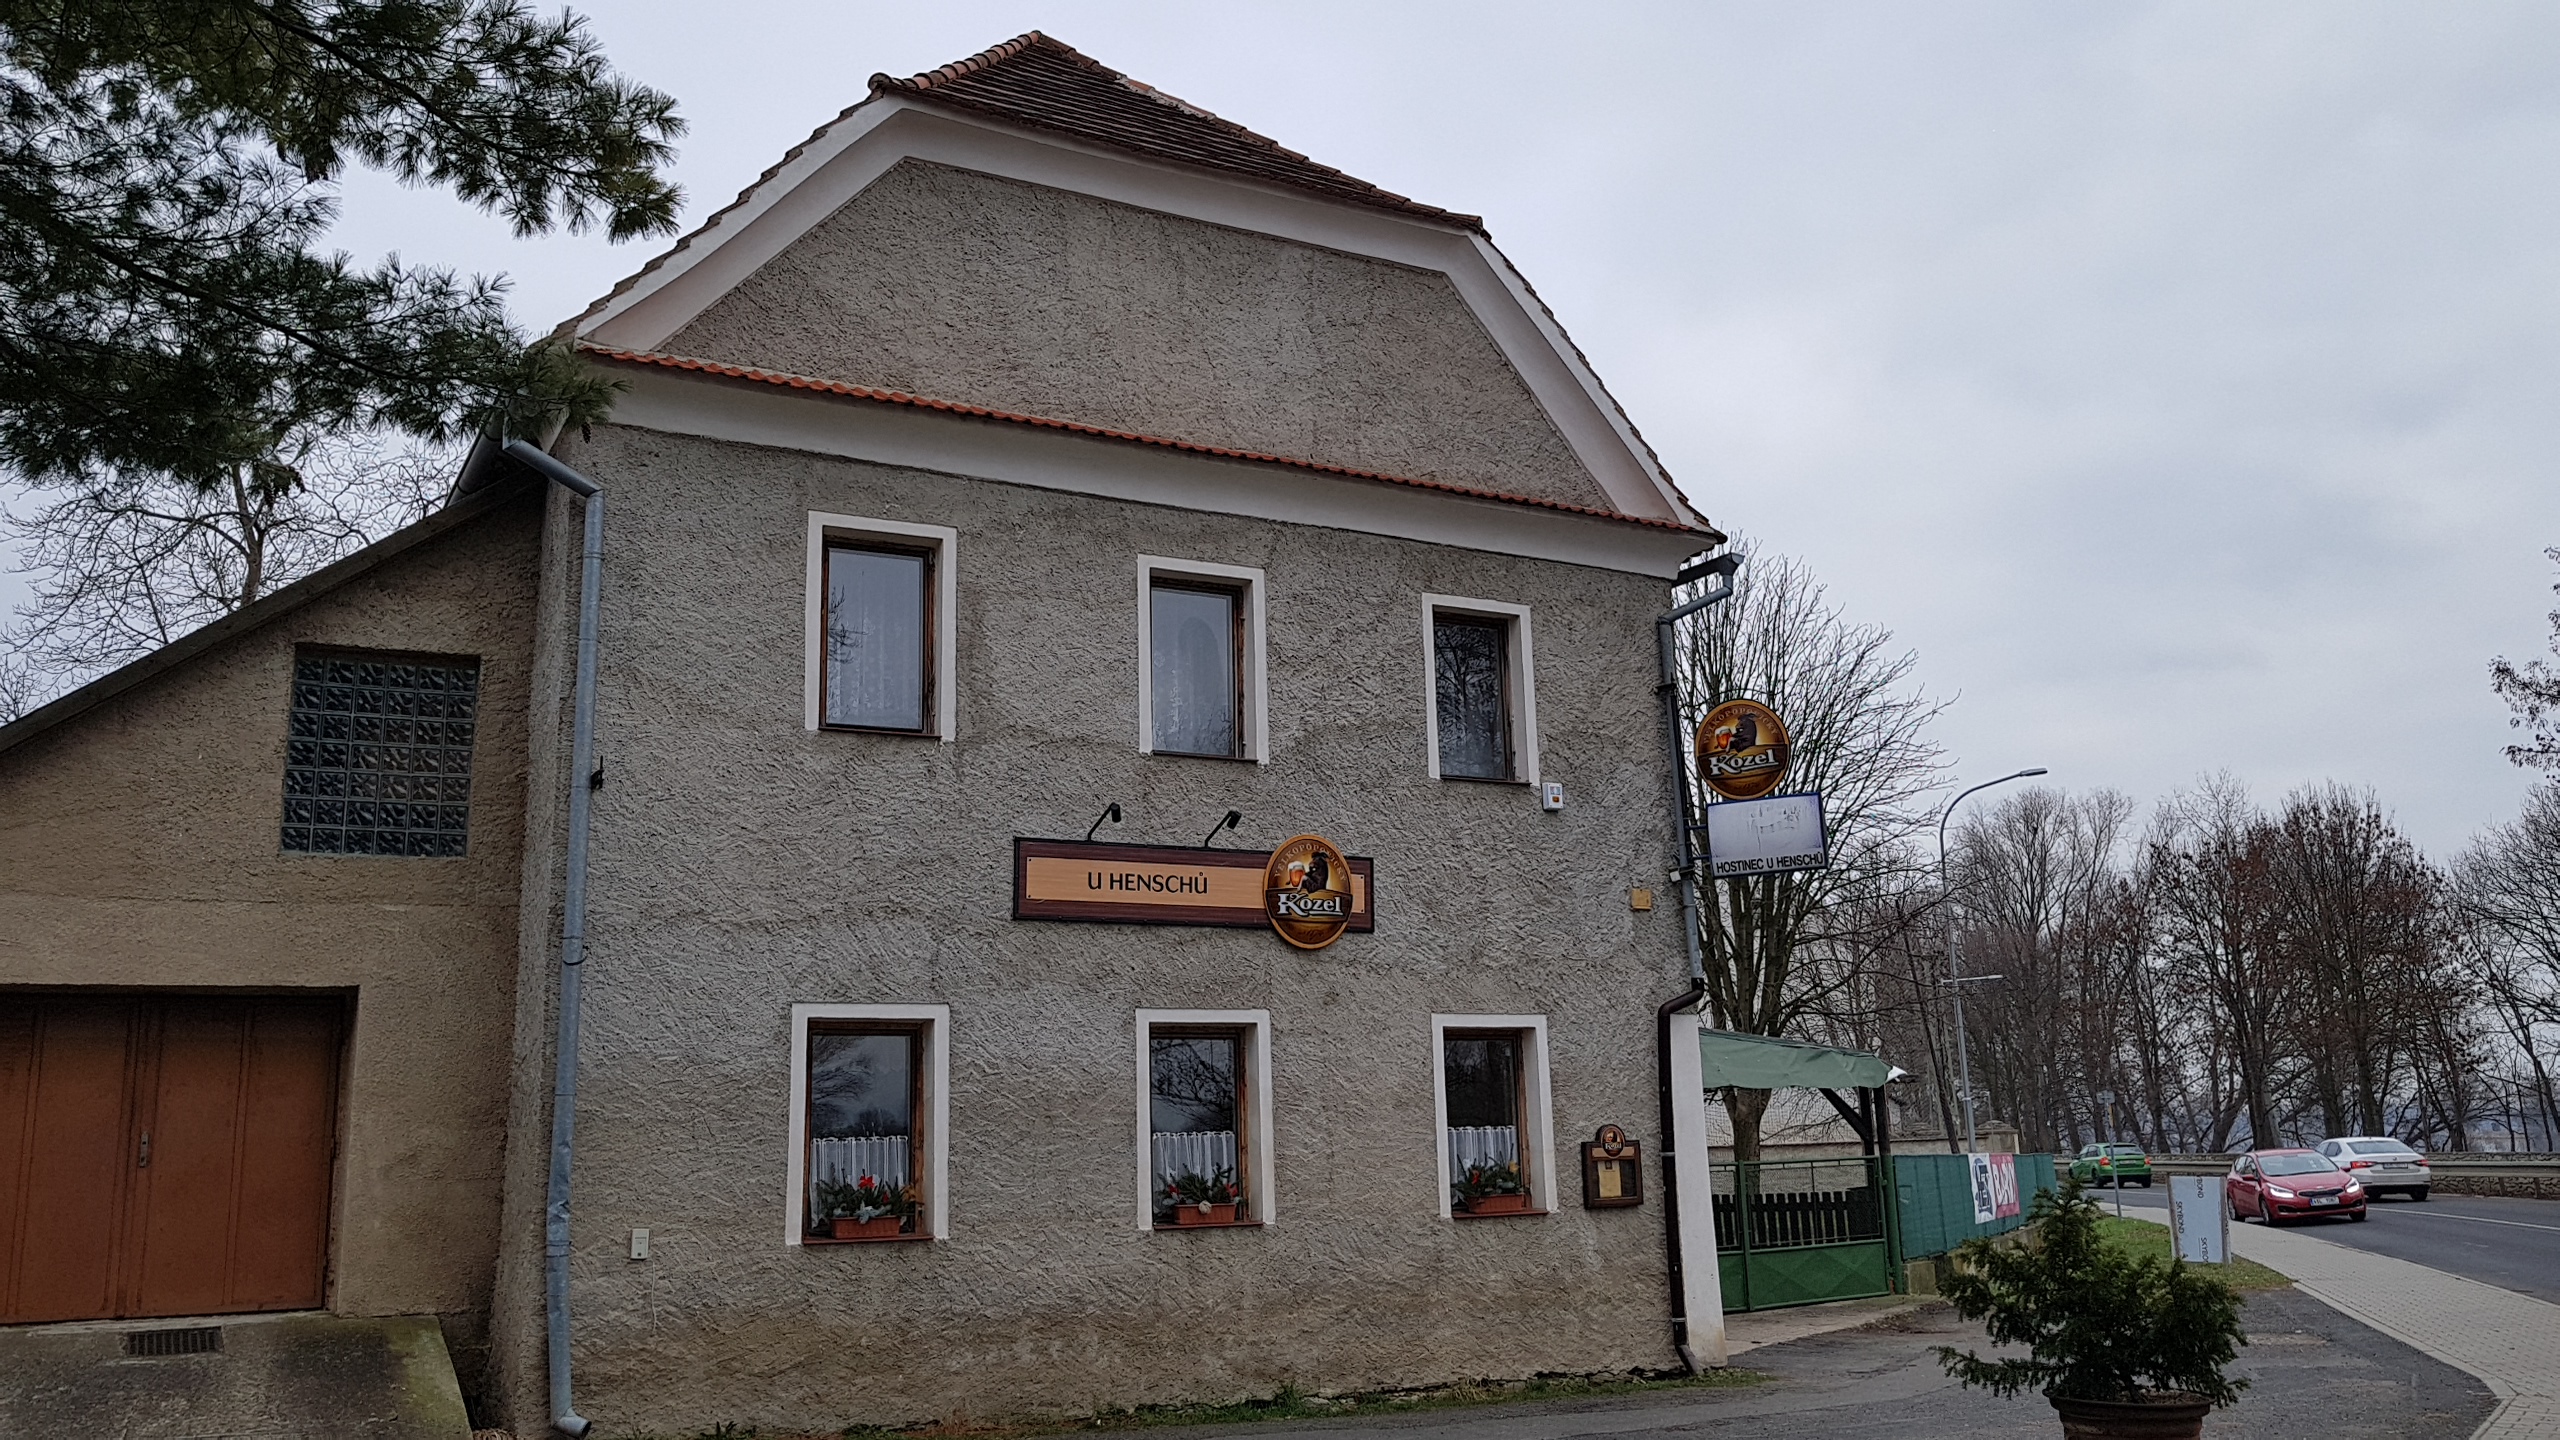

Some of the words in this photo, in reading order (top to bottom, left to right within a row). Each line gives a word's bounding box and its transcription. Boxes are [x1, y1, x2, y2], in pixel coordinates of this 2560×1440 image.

[1708, 748, 1779, 776] Kozel
[1716, 858, 1764, 873] HOSTINEC
[1766, 856, 1774, 869] U
[1776, 851, 1824, 868] HENSCHŮ
[1088, 871, 1101, 890] U
[1109, 871, 1208, 894] HENSCHŮ
[1277, 893, 1343, 916] Kozel
[2175, 1201, 2185, 1234] SKYBOND
[2200, 1237, 2209, 1263] SKYBO
